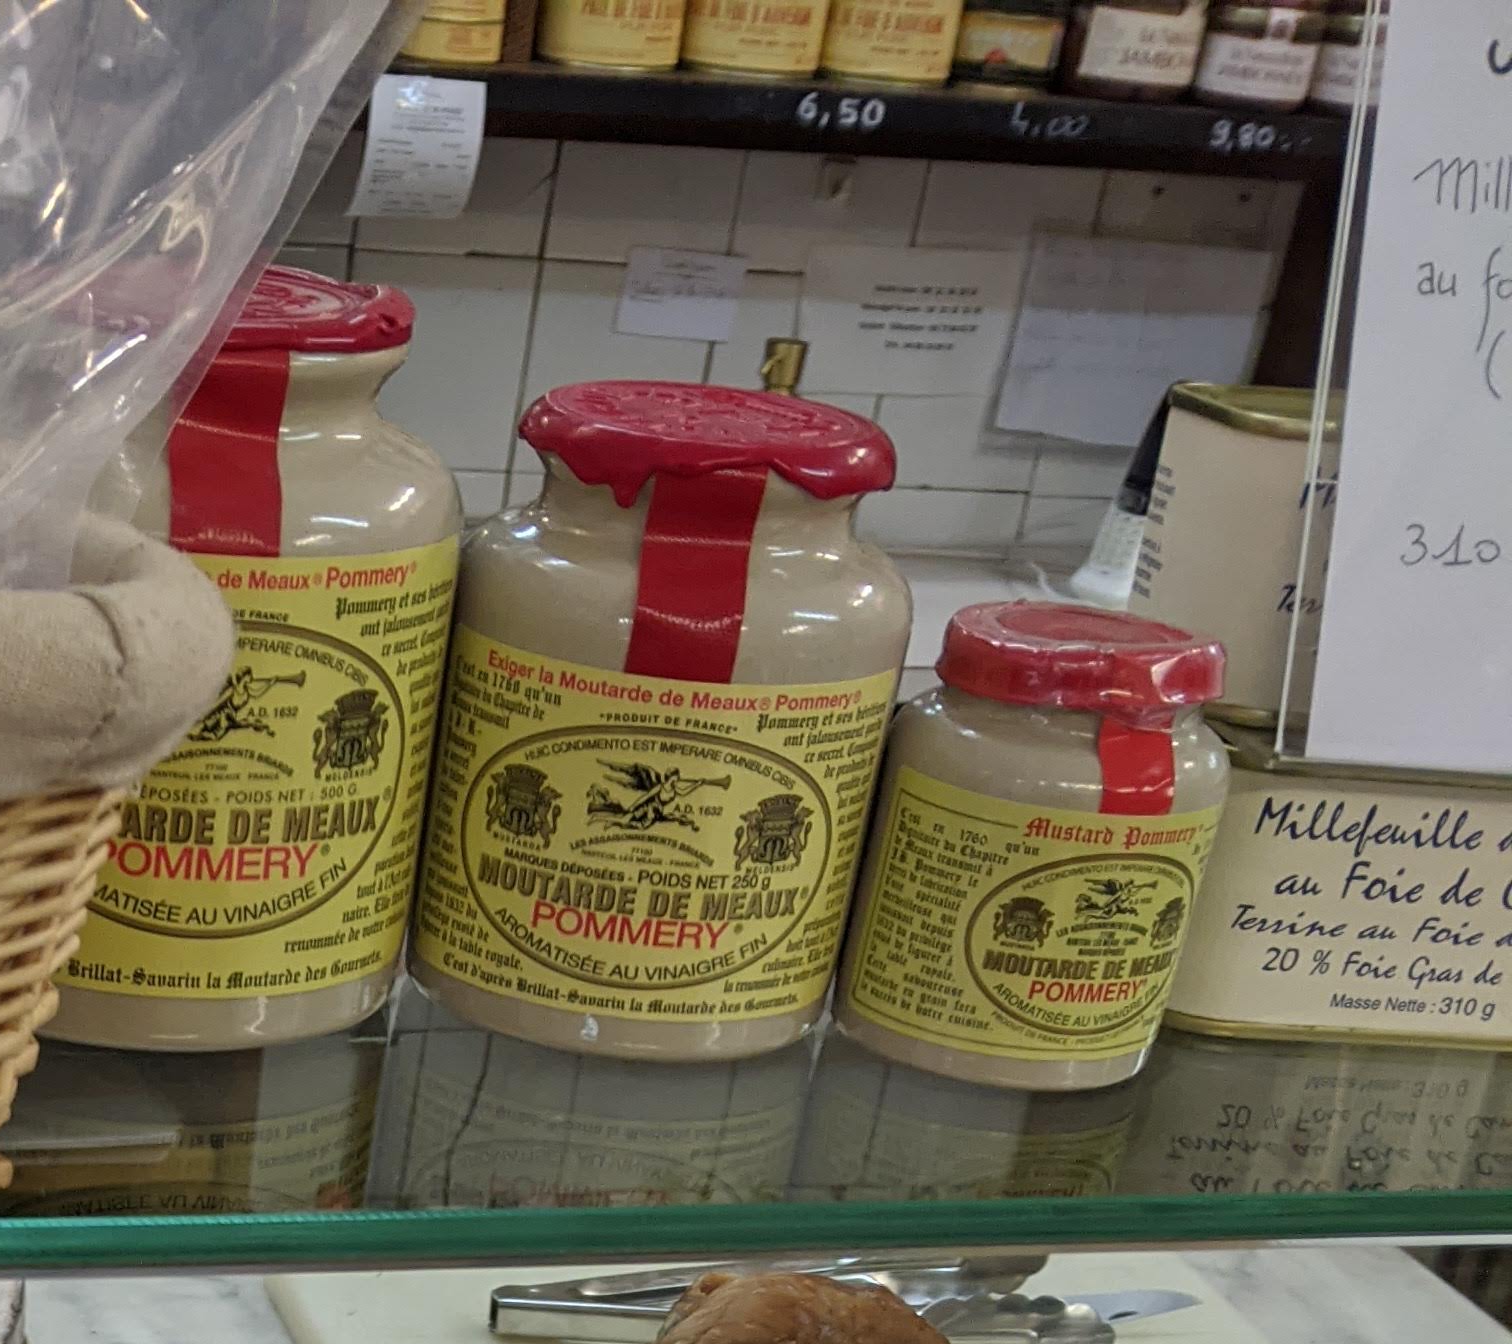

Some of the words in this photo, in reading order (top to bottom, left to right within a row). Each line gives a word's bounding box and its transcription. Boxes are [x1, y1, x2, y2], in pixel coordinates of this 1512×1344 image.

[795, 91, 887, 129] 6,50
[1418, 262, 1457, 297] au
[217, 568, 243, 589] de
[249, 609, 290, 622] FRANCE
[488, 649, 535, 681] Exiger
[539, 664, 554, 685] la
[559, 670, 654, 704] Moutarde
[659, 687, 685, 708] de
[605, 712, 659, 725] PRODUIT
[664, 714, 681, 726] DE
[756, 712, 818, 734] Pommery
[632, 738, 657, 751] EST
[226, 788, 272, 805] POIDS
[278, 787, 307, 803] NET
[319, 784, 344, 800] 500
[227, 806, 274, 846] DE
[281, 795, 381, 842] MEAUX
[1023, 816, 1115, 847] Mustard
[1255, 797, 1484, 858] Millefeuille
[960, 828, 989, 847] 1760
[1005, 840, 1041, 857] qu'un
[477, 853, 638, 918] MOUTARDE
[645, 888, 691, 921] DE
[699, 885, 800, 923] MEAUX
[504, 847, 560, 872] MARQUES
[560, 859, 626, 883] DÉPOSÉES
[638, 868, 691, 890] POIDS
[695, 872, 728, 889] NET
[732, 872, 759, 889] 250
[761, 875, 772, 892] g
[1275, 873, 1322, 897] au
[1341, 861, 1425, 904] Foie
[1440, 868, 1485, 908] de
[184, 905, 219, 926] AU
[223, 883, 317, 924] VINAIGRE
[319, 856, 348, 890] FIN
[530, 898, 731, 951] POMMERY
[1231, 903, 1349, 939] Terrine
[1358, 924, 1398, 941] au
[1412, 917, 1485, 949] Foie
[494, 906, 608, 977] AROMATISÉE
[609, 960, 639, 981] AU
[643, 950, 737, 982] VINAIGRE
[740, 932, 769, 961] FIN
[206, 970, 222, 990] la
[226, 963, 302, 990] Moutarde
[305, 961, 328, 983] des
[982, 948, 1101, 982] MOUTARDE
[1101, 957, 1126, 980] DE
[1262, 947, 1300, 973] 20
[1309, 949, 1332, 976] %
[1340, 951, 1398, 980] Foie
[1407, 956, 1464, 990] Gras
[1473, 960, 1503, 985] de
[516, 976, 626, 1012] Brillat-Savarin
[629, 996, 644, 1013] la
[646, 998, 717, 1016] Moutarde
[719, 997, 742, 1013] des
[992, 982, 1072, 1026] AROMATISÉE
[1073, 1015, 1089, 1028] AU
[1027, 979, 1140, 1005] POMMERY
[1329, 993, 1381, 1012] Masse
[1384, 998, 1427, 1014] Nette
[1439, 997, 1477, 1017] 310
[1482, 1002, 1496, 1021] g
